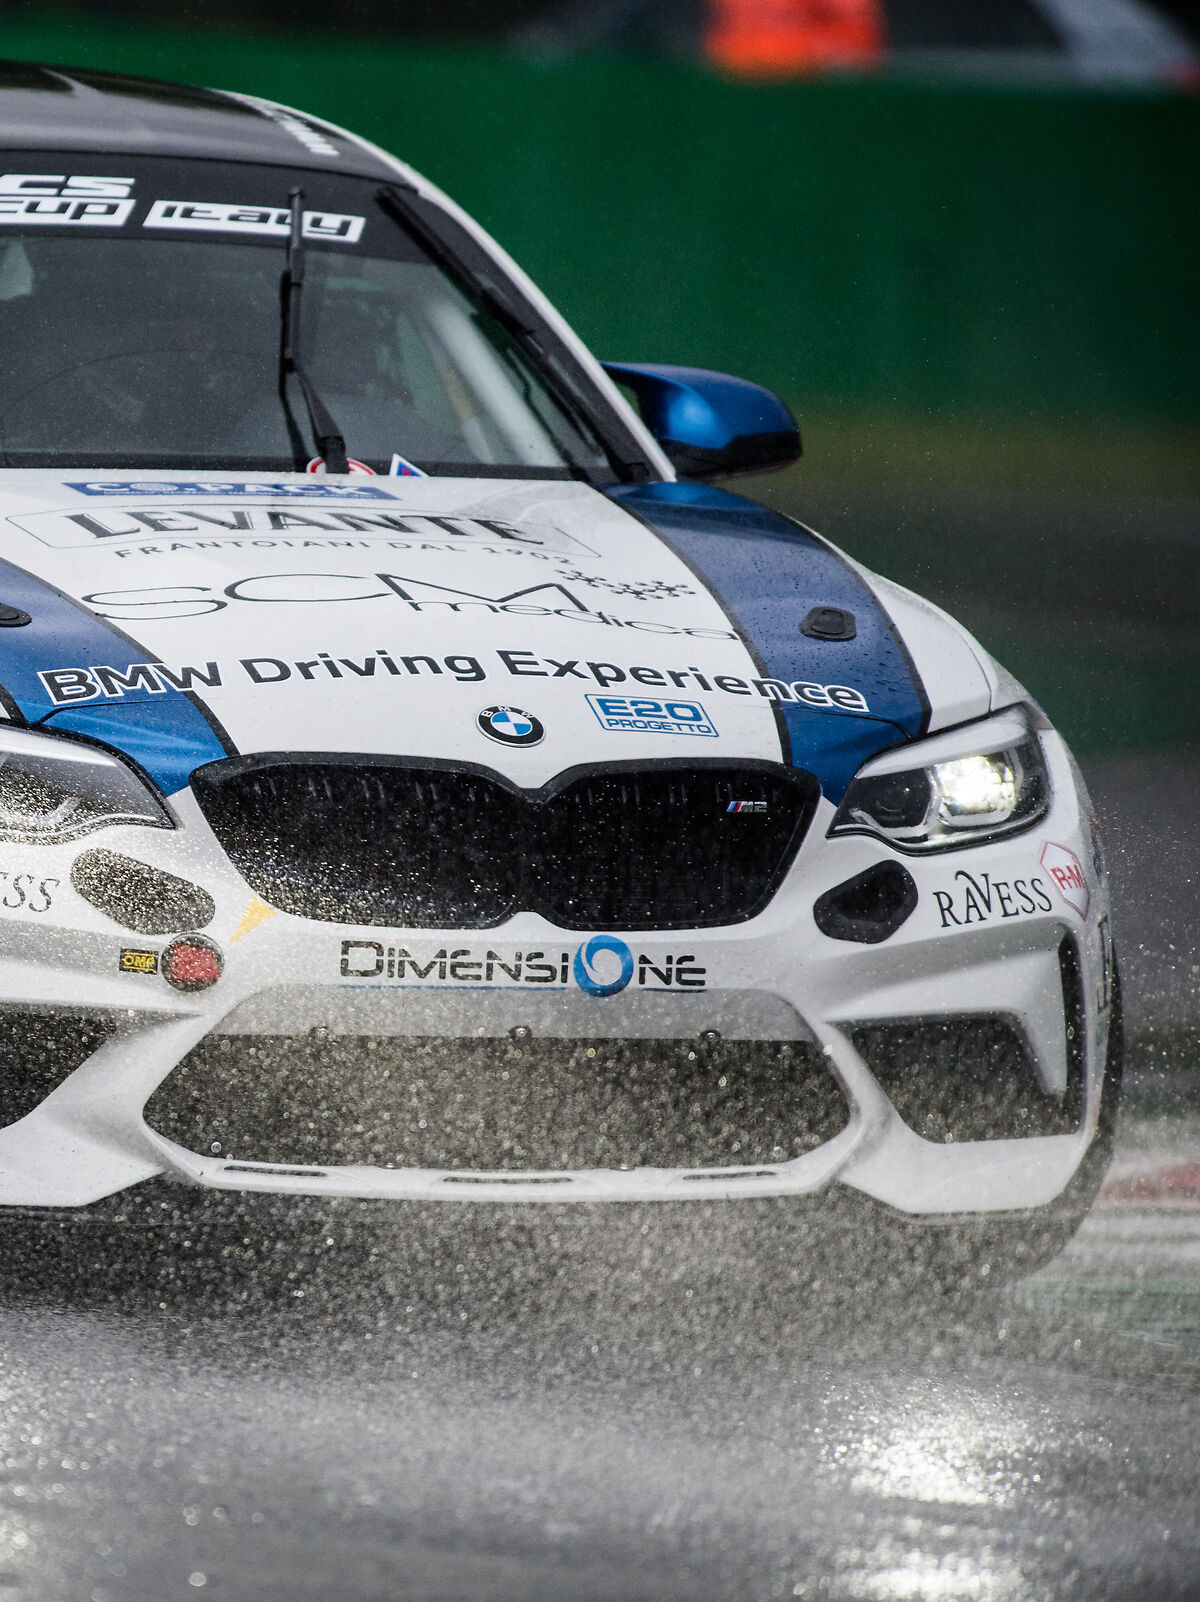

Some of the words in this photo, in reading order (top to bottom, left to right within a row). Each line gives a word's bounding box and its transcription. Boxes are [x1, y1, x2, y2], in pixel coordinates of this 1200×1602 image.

[65, 509, 544, 545] LEVANTE
[114, 540, 372, 559] FRANTOIANI
[388, 541, 466, 553] DAL
[484, 546, 575, 565] 1902
[82, 572, 588, 621] SCM
[37, 658, 224, 706] BMW
[239, 648, 487, 682] Driving
[495, 649, 870, 713] Experience
[598, 698, 702, 722] E20
[604, 717, 715, 735] PROGETTO
[1050, 863, 1087, 891] R-M
[932, 870, 1053, 928] RAVESS
[123, 954, 156, 968] OMP
